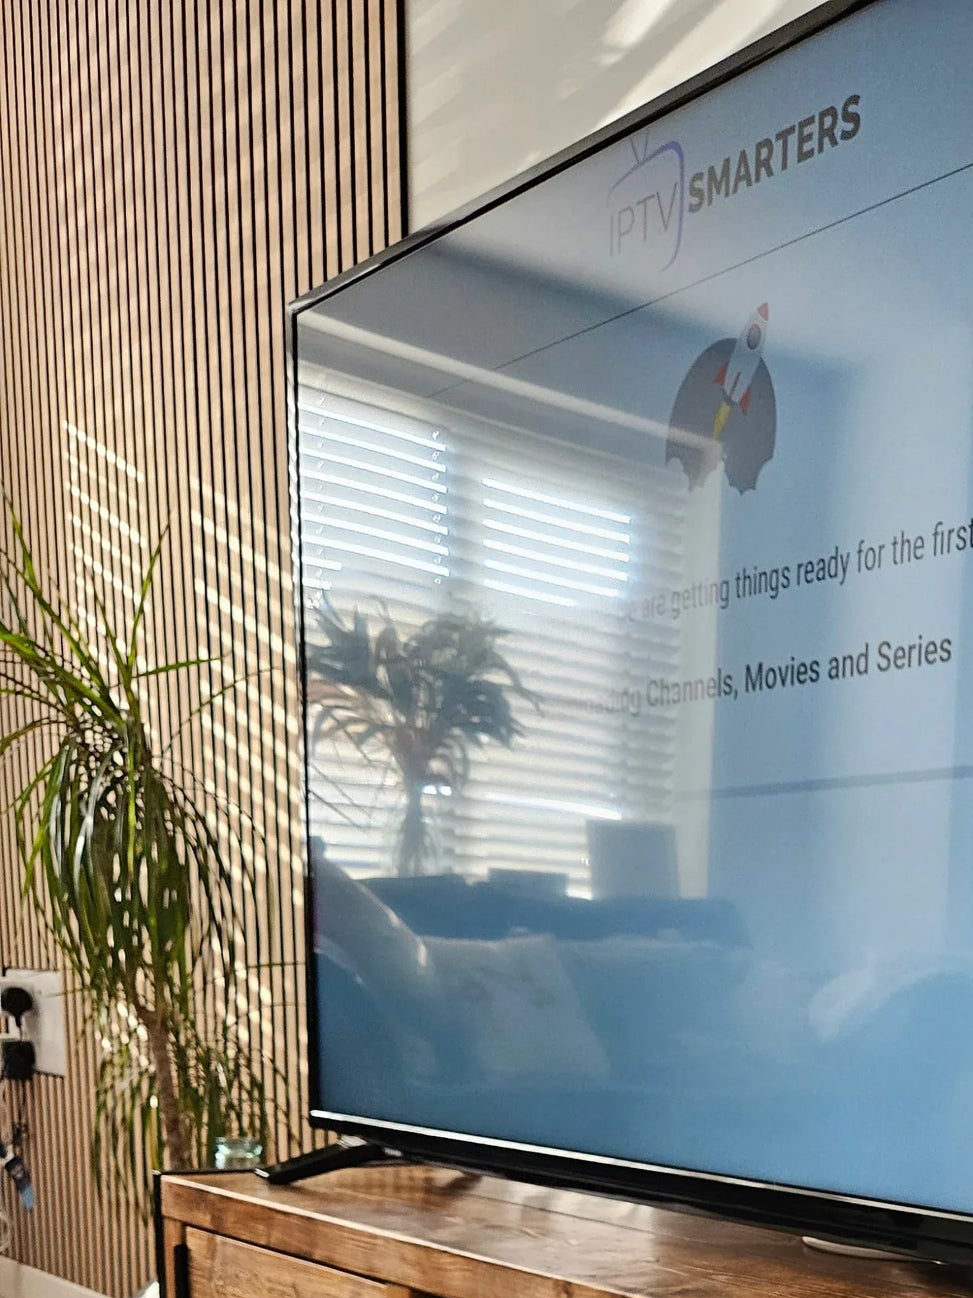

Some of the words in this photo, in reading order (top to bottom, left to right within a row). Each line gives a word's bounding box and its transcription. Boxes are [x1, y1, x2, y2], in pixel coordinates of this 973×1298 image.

[608, 181, 679, 258] IPTV
[687, 94, 862, 214] SMARTERS
[671, 578, 730, 620] getting
[735, 565, 791, 600] things
[797, 545, 850, 586] ready
[856, 539, 885, 573] for
[891, 530, 925, 566] the
[646, 668, 739, 708] Channels,
[744, 656, 820, 694] Movies
[827, 642, 869, 681] and
[877, 634, 952, 673] Series
